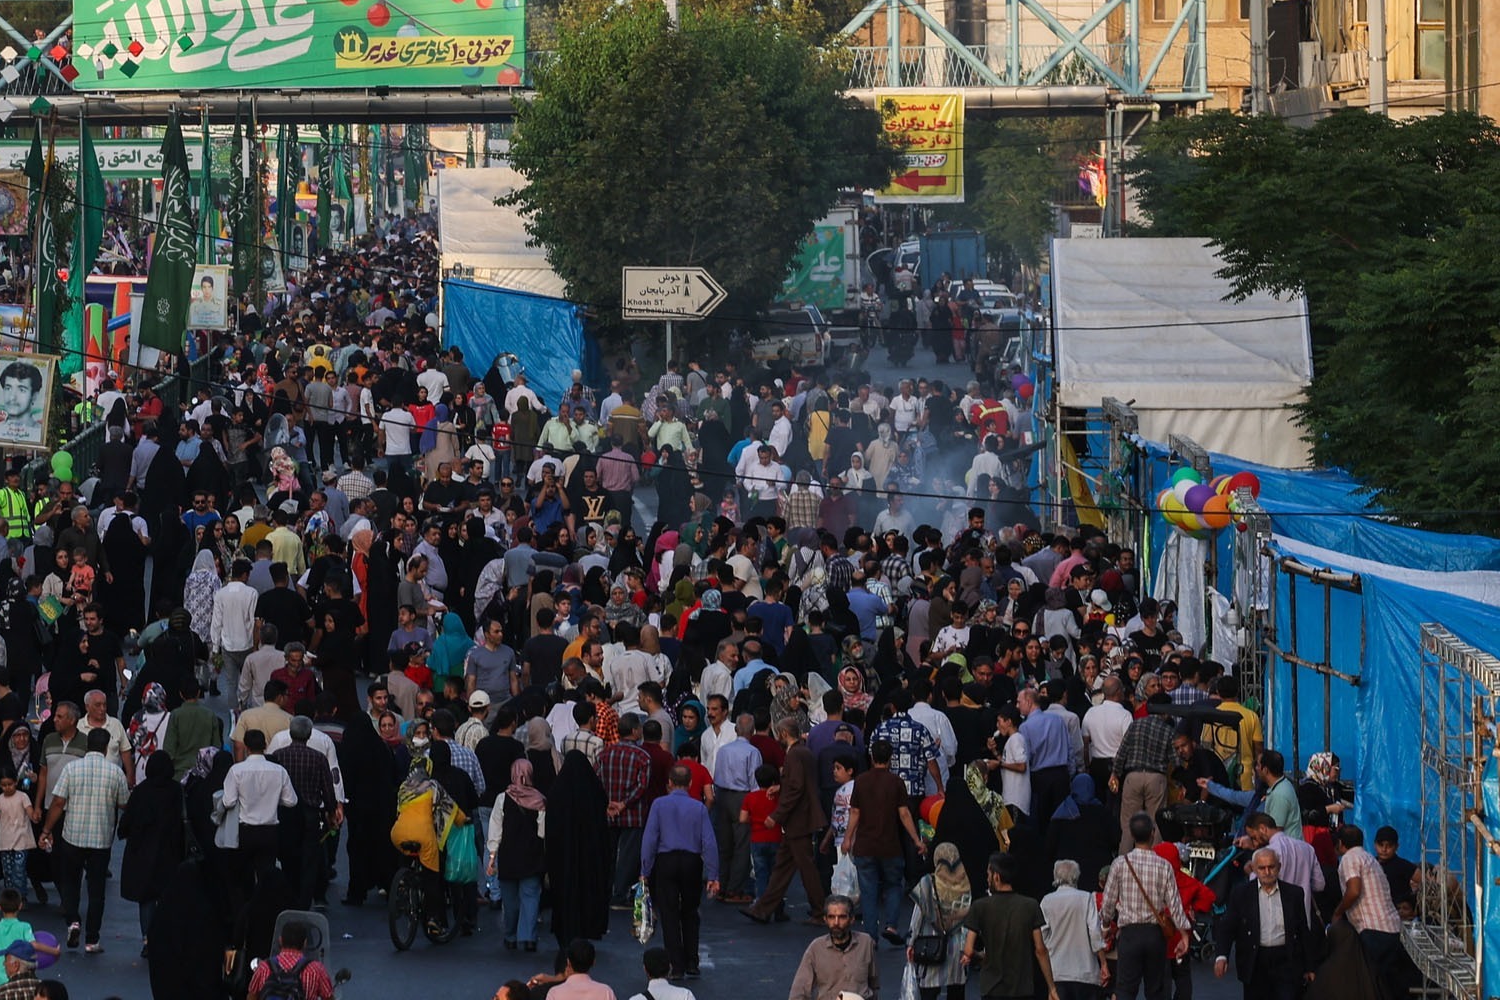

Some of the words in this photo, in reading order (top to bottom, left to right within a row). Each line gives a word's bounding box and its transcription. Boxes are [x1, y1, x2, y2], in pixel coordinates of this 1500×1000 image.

[361, 40, 399, 65] غدیر
[399, 38, 455, 66] کیلومتری
[929, 103, 940, 114] به
[885, 116, 925, 132] برگزاری
[929, 133, 952, 149] نماز
[658, 273, 681, 284] خوش
[639, 285, 681, 296] آذربایجان
